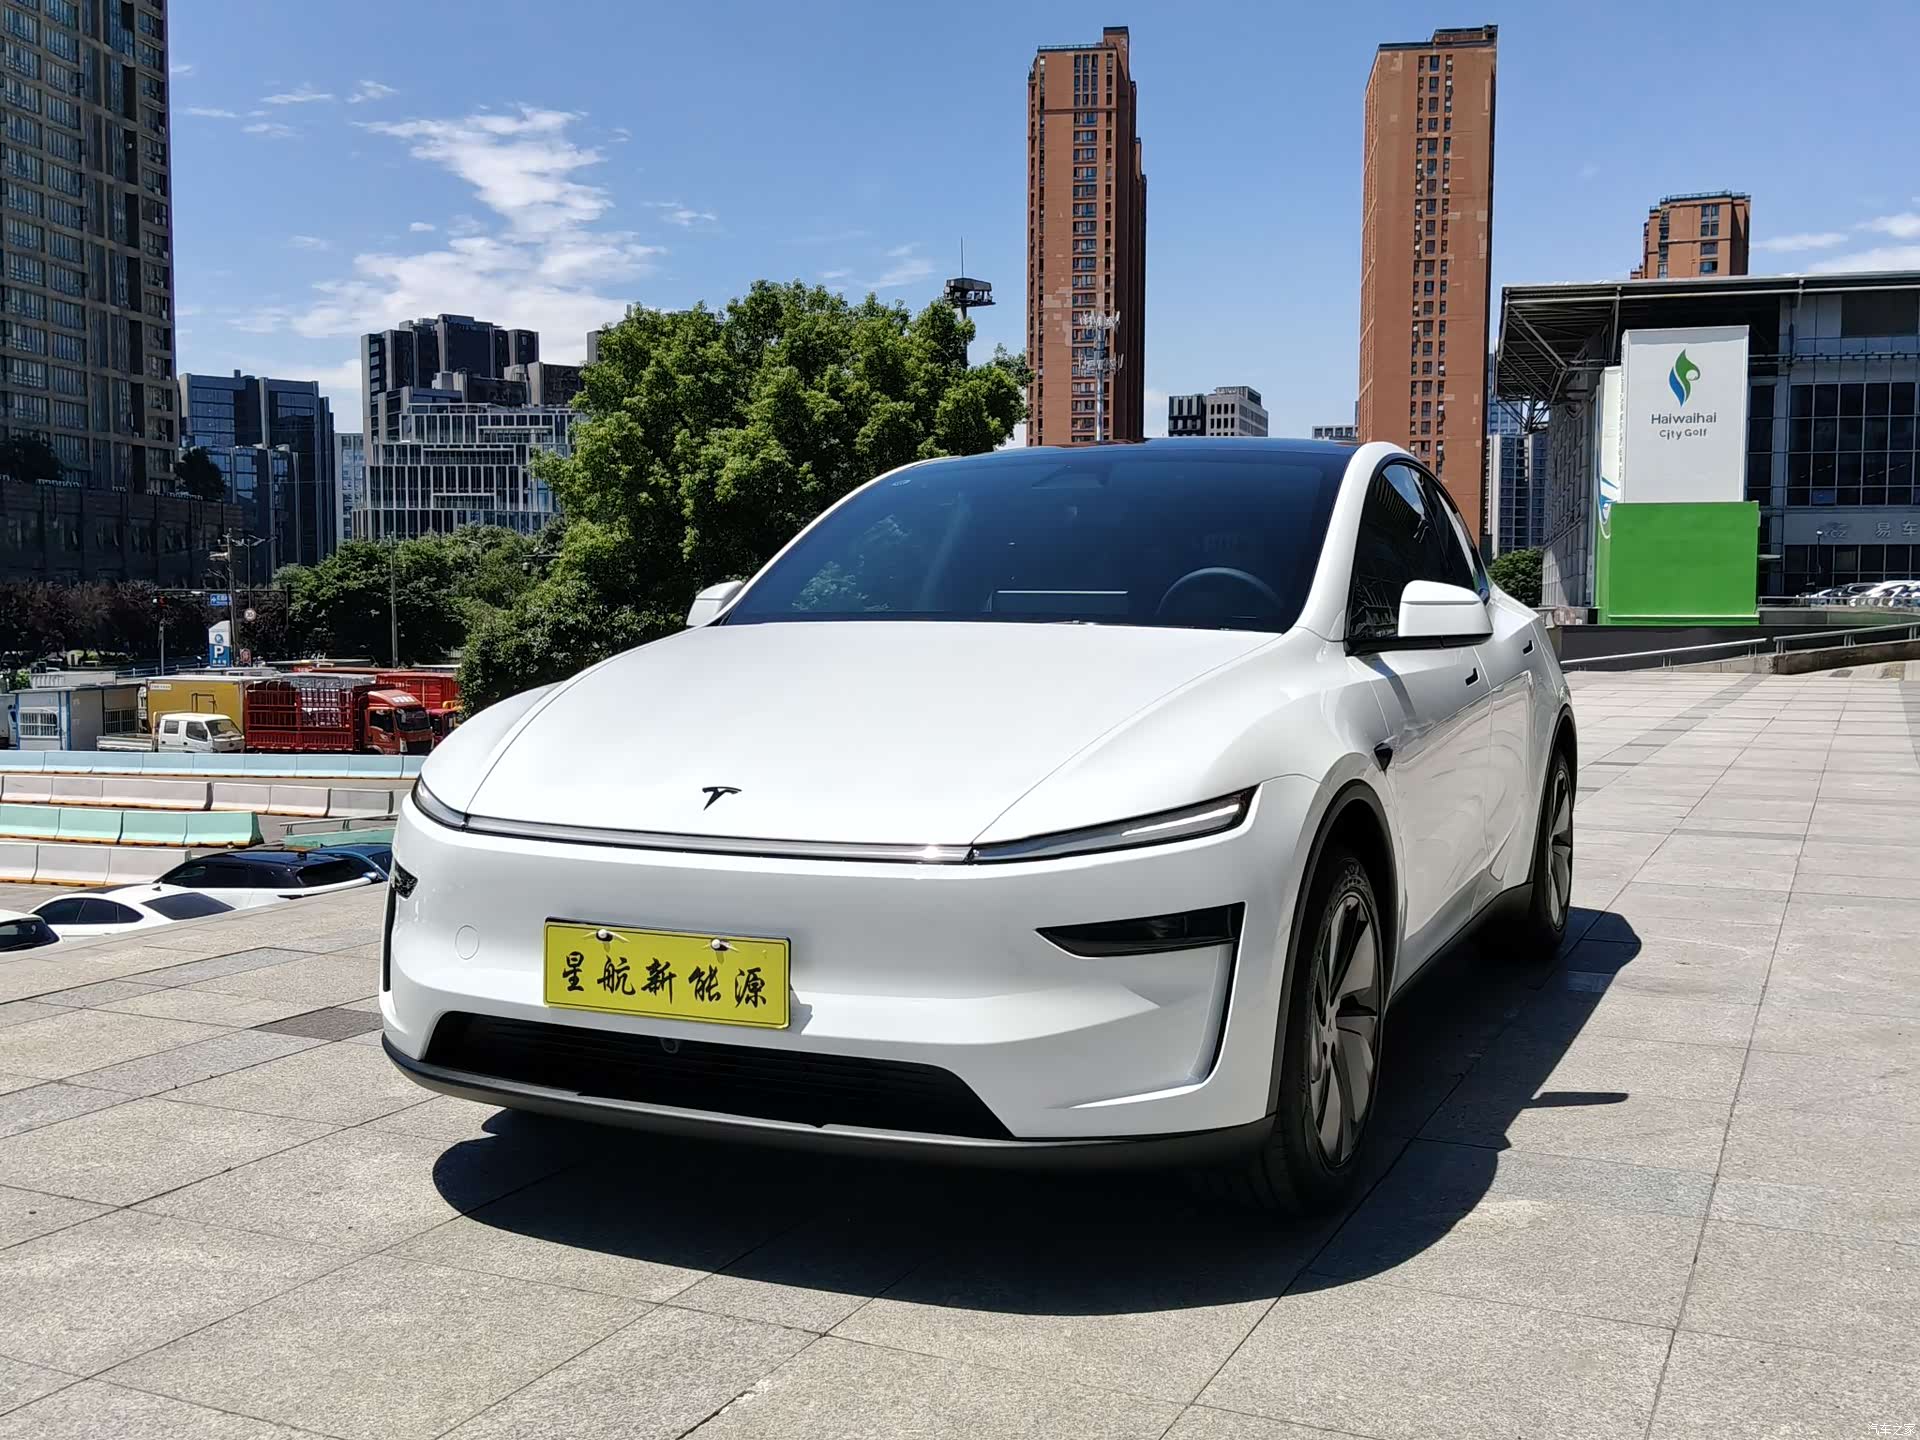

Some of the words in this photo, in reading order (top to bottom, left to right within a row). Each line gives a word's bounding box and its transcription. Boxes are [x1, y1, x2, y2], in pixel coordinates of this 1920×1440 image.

[1651, 412, 1717, 425] Haiwaihai
[1659, 429, 1682, 440] City
[1684, 428, 1707, 437] Golf
[1875, 520, 1919, 538] 易车
[213, 645, 225, 659] P
[561, 951, 768, 1009] 星航新能源
